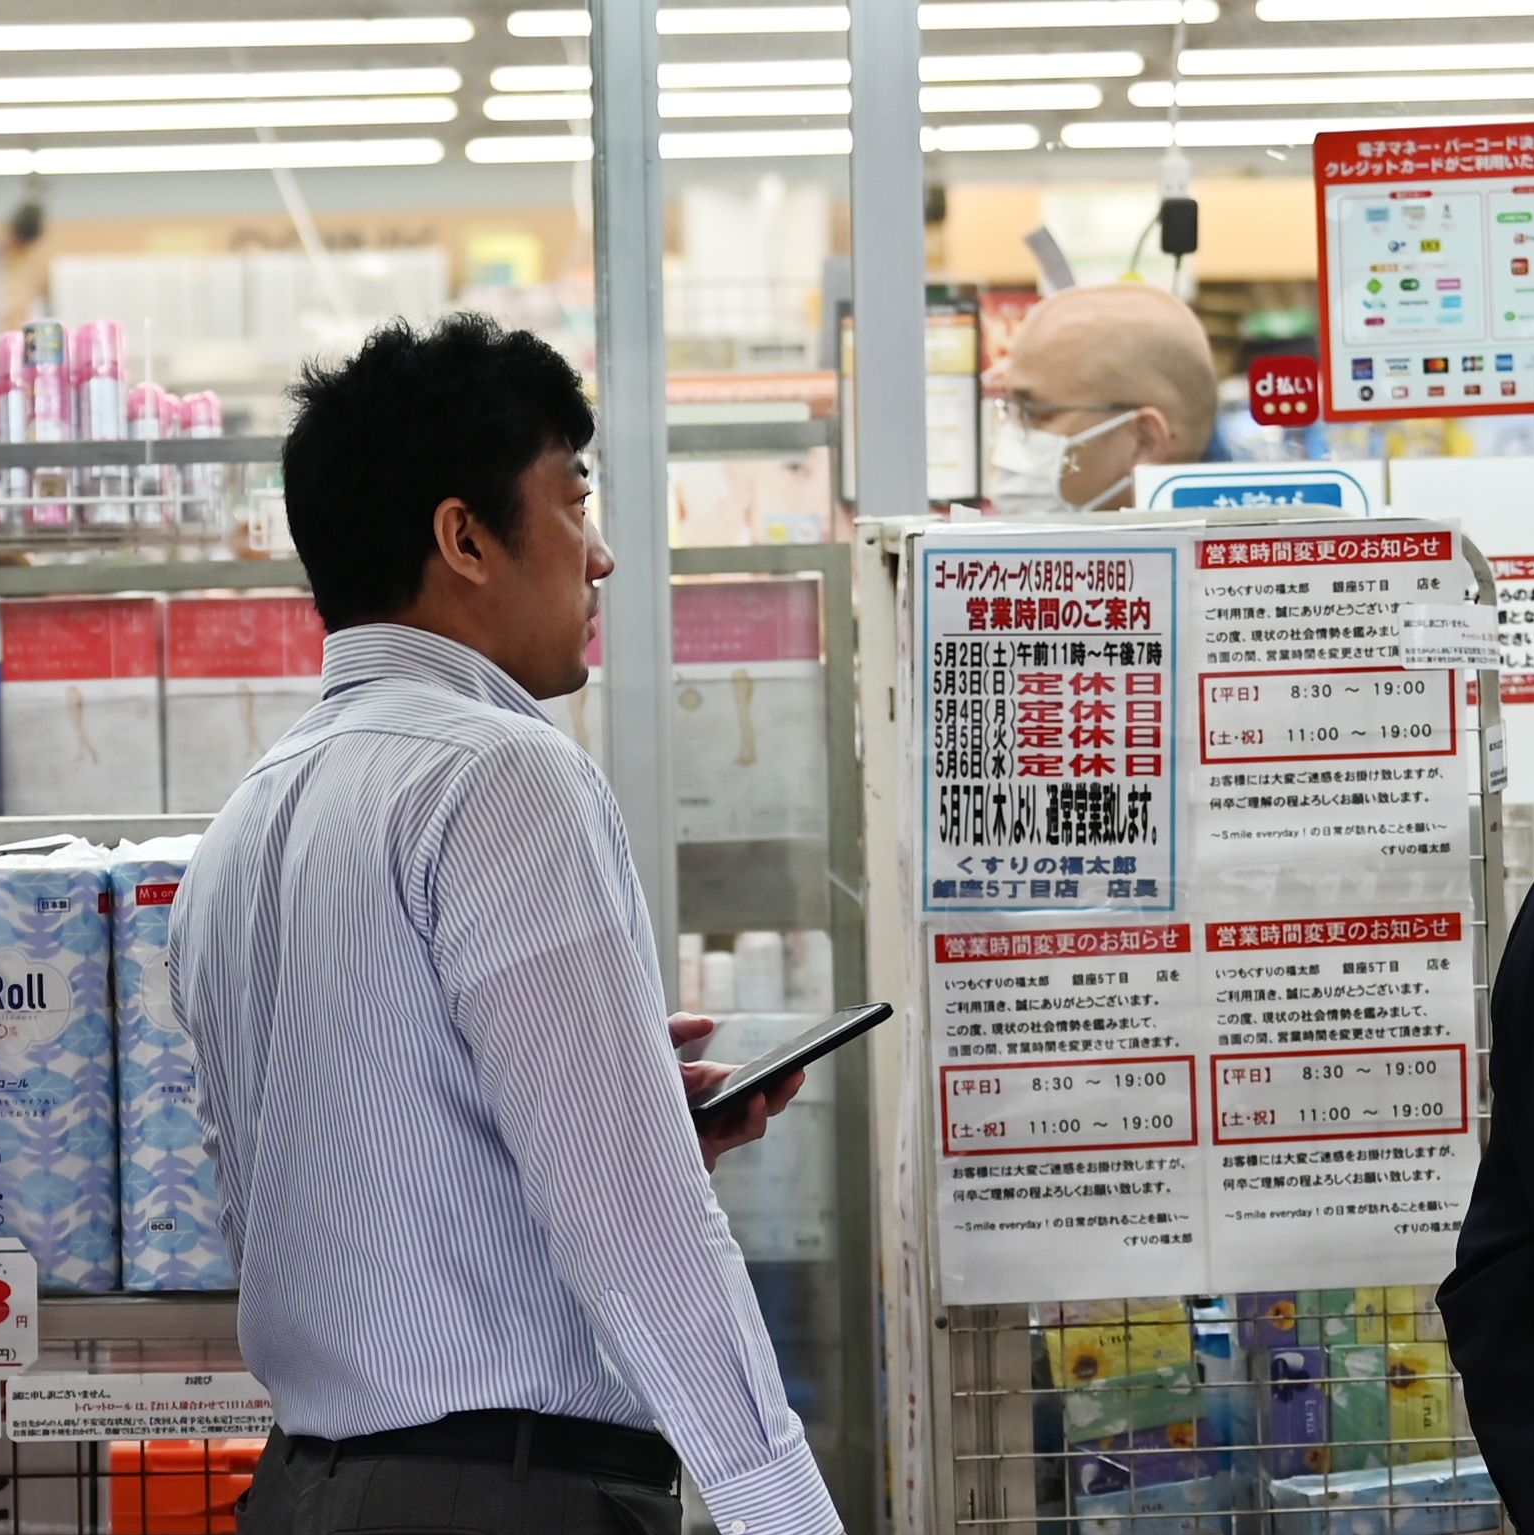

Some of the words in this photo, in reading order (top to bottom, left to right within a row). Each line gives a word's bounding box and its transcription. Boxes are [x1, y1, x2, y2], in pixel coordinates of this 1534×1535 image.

[1205, 537, 1440, 566] 営業時間変更のお知らせ
[1205, 582, 1309, 597] いつもくすりの福太郎
[1332, 580, 1389, 593] 銀座5丁目
[1417, 578, 1441, 590] 店を
[966, 597, 1150, 631] 営業時間のご案内
[1205, 601, 1413, 620] ご利用頂き、誠にありがとうございま
[1211, 686, 1259, 702] 【平日】
[1291, 684, 1332, 699] 8:30
[1374, 681, 1425, 696] 19:00
[1287, 727, 1339, 742] 11:00
[1381, 724, 1432, 738] 19:00
[1381, 843, 1450, 855] くすりの福太郎
[957, 856, 1137, 875] くすりの福太郎
[1107, 879, 1158, 898] 店長
[41, 901, 67, 910] 日本製
[1216, 918, 1449, 947] 営業時間変更のお知らせ
[946, 929, 1179, 958] 営業時間変更のお知らせ
[1216, 965, 1320, 978] いつもくすりの福太郎
[1343, 961, 1399, 975] 銀座5丁目
[1427, 959, 1450, 971] 店を
[945, 976, 1049, 991] いつもくすりの福太郎
[1072, 972, 1128, 985] 銀座5丁目
[1156, 970, 1180, 982] 店を
[1223, 1067, 1272, 1084] 【平日】
[1302, 1065, 1344, 1080] 8:30
[1385, 1061, 1437, 1075] 19:00
[953, 1078, 1001, 1096] 【平日】
[1032, 1077, 1073, 1092] 8:30
[1115, 1072, 1166, 1087] 19:00
[1300, 1107, 1351, 1121] 11:00
[1392, 1103, 1443, 1117] 19:00
[1030, 1119, 1080, 1134] 11:00
[1122, 1115, 1173, 1129] 19:00
[1394, 1222, 1462, 1234] くすりの福太郎
[1123, 1233, 1193, 1246] くすりの福太郎
[16, 1315, 28, 1328] 円
